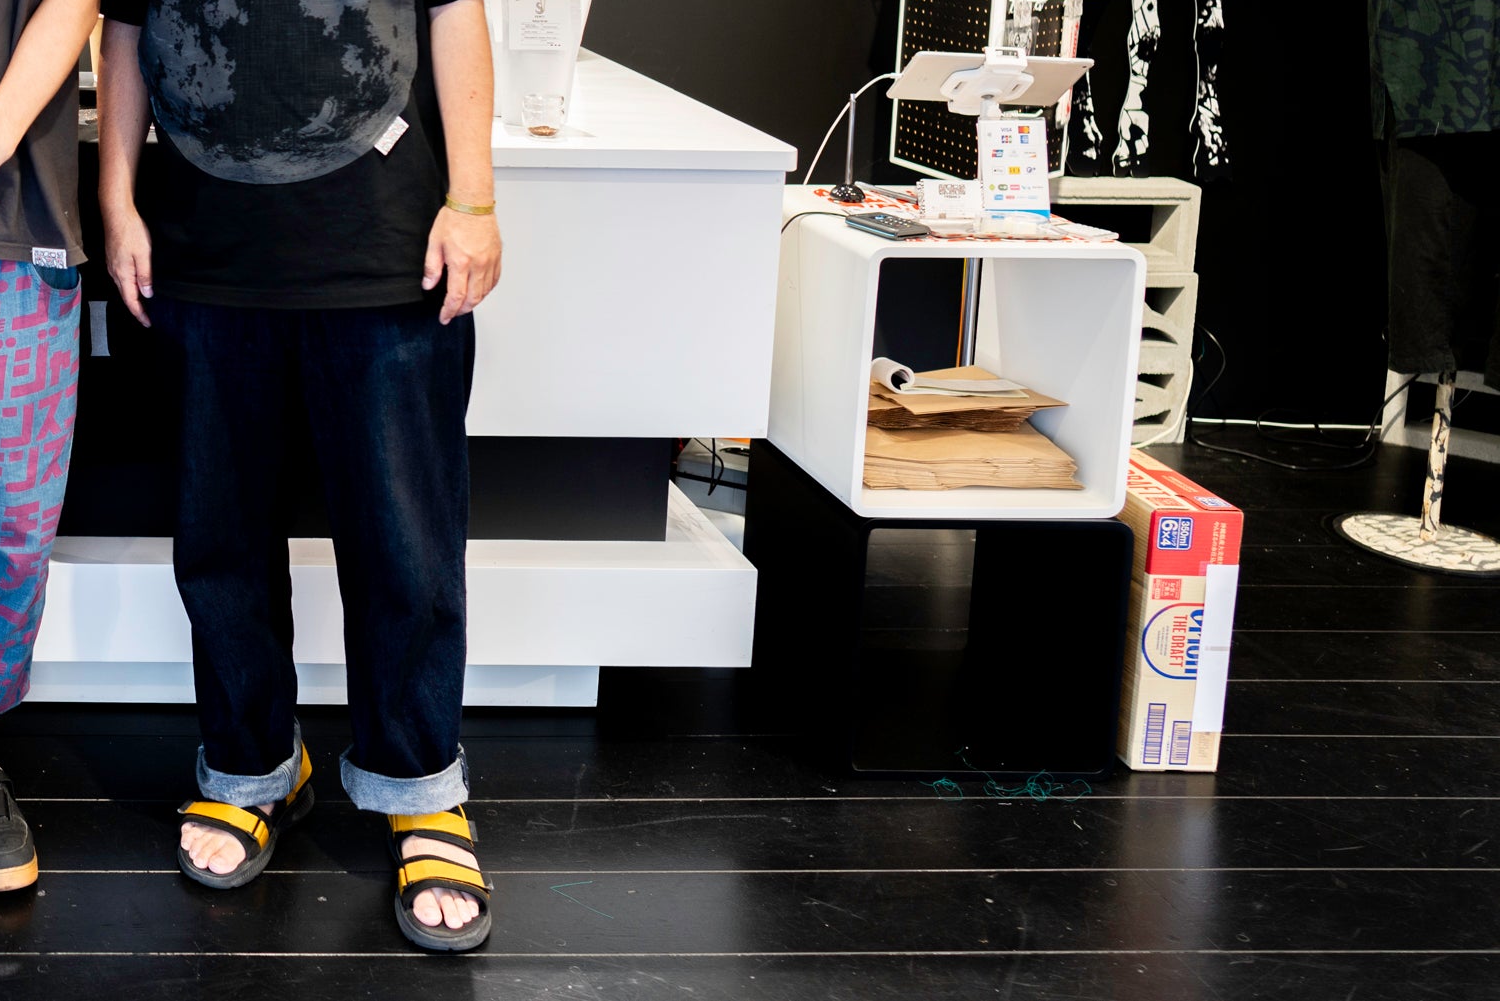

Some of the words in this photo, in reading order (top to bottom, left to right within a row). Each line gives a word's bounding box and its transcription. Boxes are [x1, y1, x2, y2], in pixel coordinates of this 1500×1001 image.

[1180, 520, 1191, 547] 350ml
[1172, 614, 1188, 633] THE
[1169, 635, 1186, 667] DRAFT
